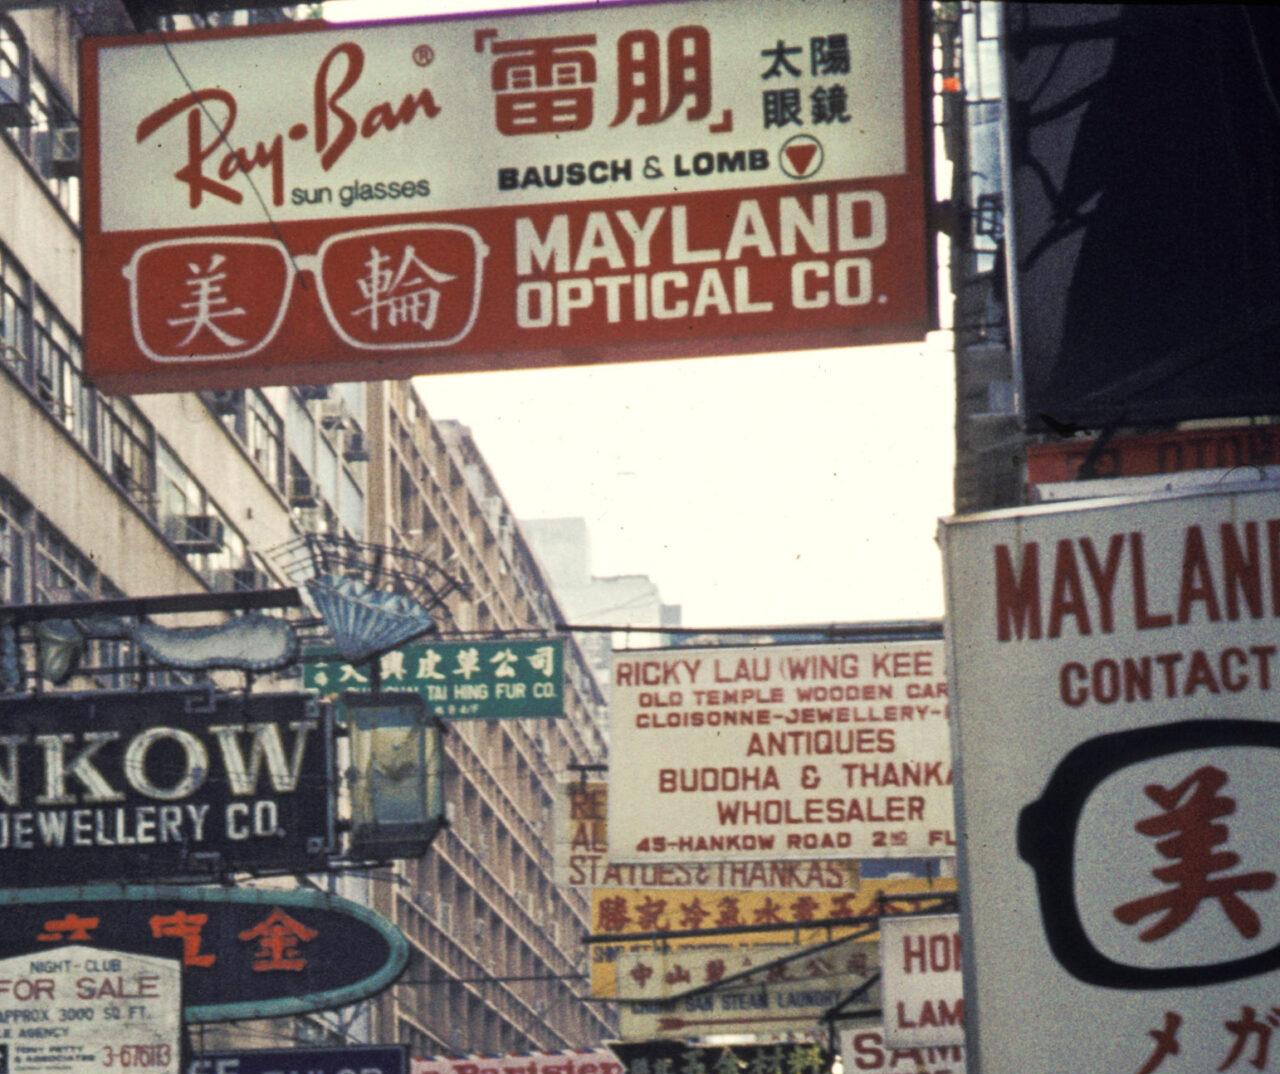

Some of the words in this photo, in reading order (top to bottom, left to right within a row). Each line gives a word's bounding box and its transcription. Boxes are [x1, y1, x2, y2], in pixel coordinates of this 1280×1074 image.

[761, 33, 851, 80] 太陽
[762, 84, 852, 129] 眼鏡
[498, 158, 632, 191] BAUSCH
[642, 155, 665, 179] &
[674, 148, 769, 177] LOMB
[291, 186, 332, 205] sun
[339, 178, 431, 208] glasses
[515, 190, 888, 276] MAYLAND
[167, 253, 246, 348] 美
[351, 243, 458, 332] 輪
[516, 267, 774, 329] OPTICAL
[791, 257, 888, 310] CO.
[617, 660, 701, 686] RICKY
[715, 657, 769, 683] LAU
[873, 652, 932, 677] KEE
[1060, 646, 1277, 706] CONTACT
[427, 686, 447, 701] TAI
[455, 684, 487, 700] HING
[496, 684, 525, 698] FUR
[639, 692, 682, 708] OLD
[693, 687, 784, 704] TEMPLE
[796, 684, 892, 702] WOODEN
[746, 728, 897, 757] ANTIQUES
[659, 766, 780, 793] BUDDHA
[801, 765, 821, 790] &
[226, 801, 286, 841] CO.
[717, 796, 925, 826] WHOLESALER
[636, 834, 774, 852] 45-HANKOW
[787, 832, 852, 850] ROAD
[1113, 766, 1277, 942] 美
[75, 975, 160, 1001] SALE
